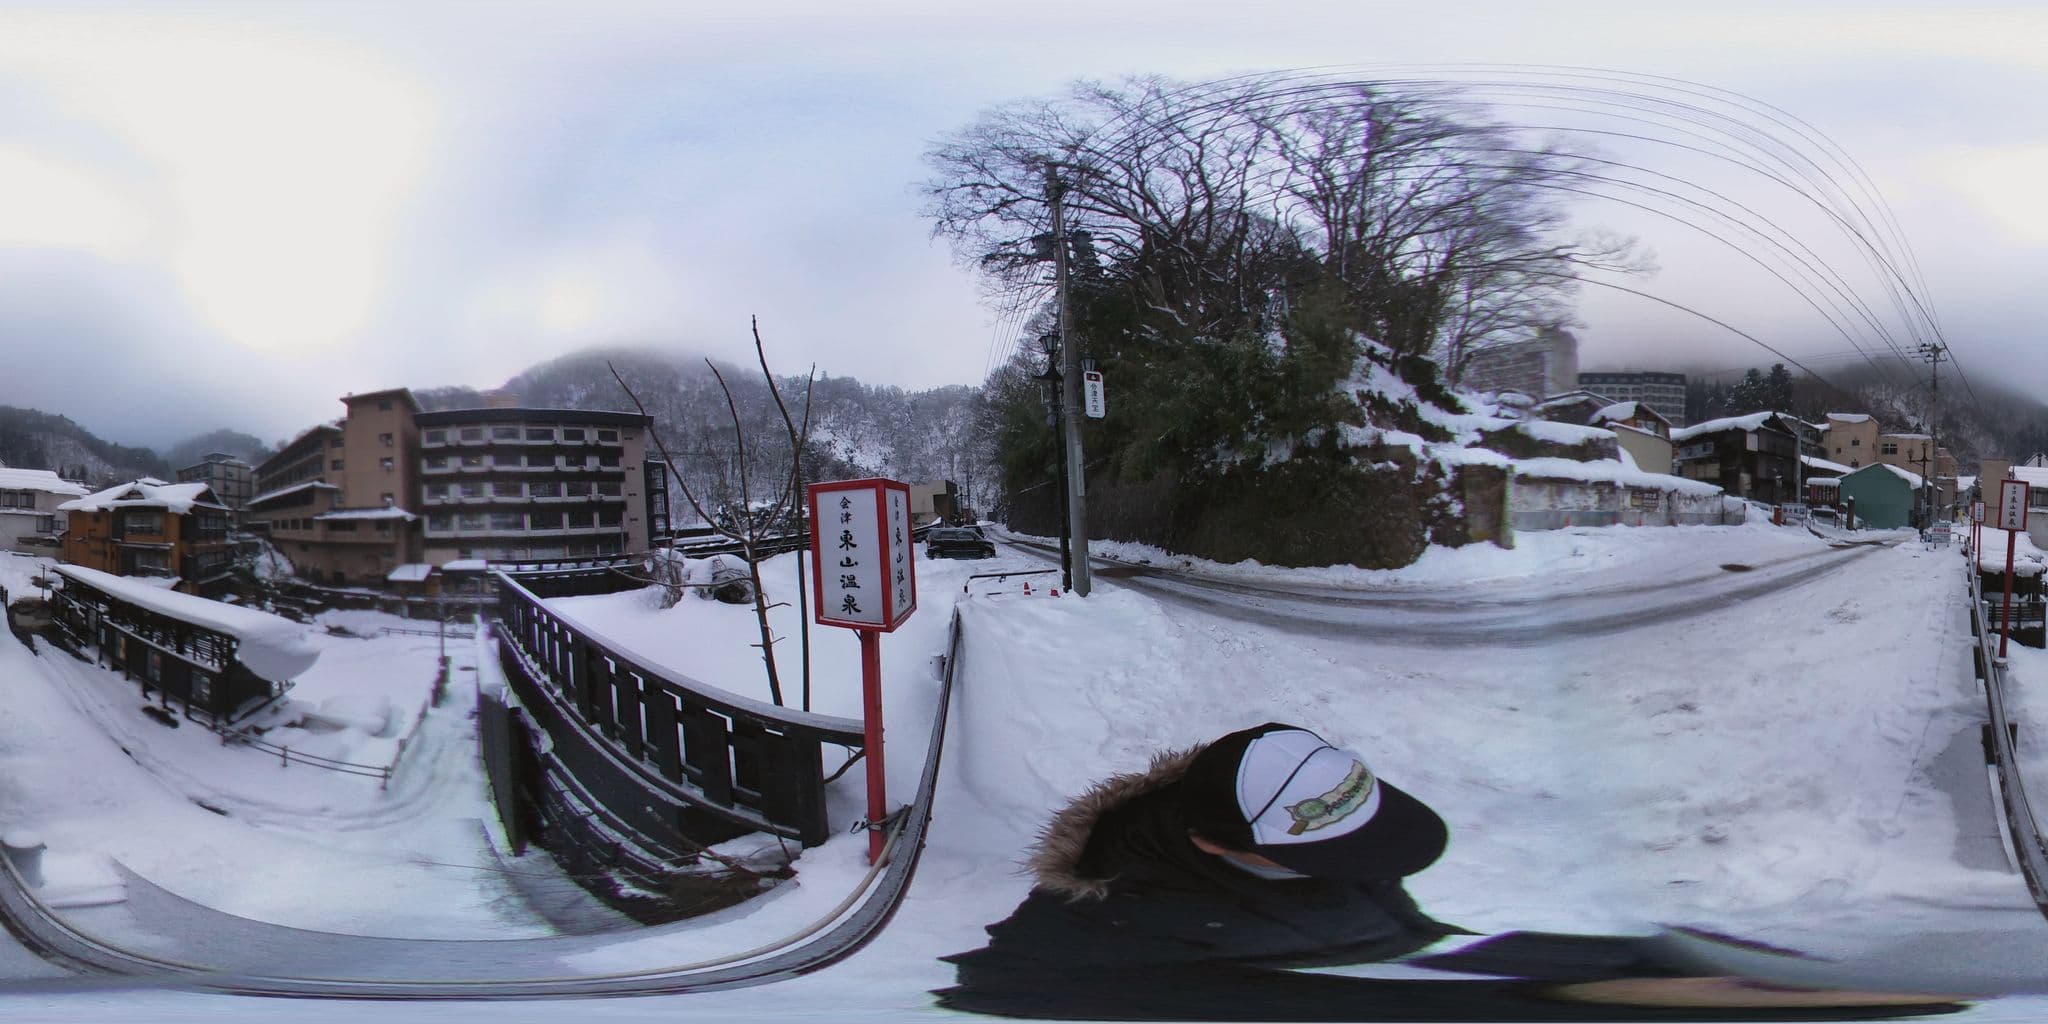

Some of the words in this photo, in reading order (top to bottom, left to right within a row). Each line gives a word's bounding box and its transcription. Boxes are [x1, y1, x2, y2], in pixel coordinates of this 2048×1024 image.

[839, 496, 862, 615] 会津東山温泉
